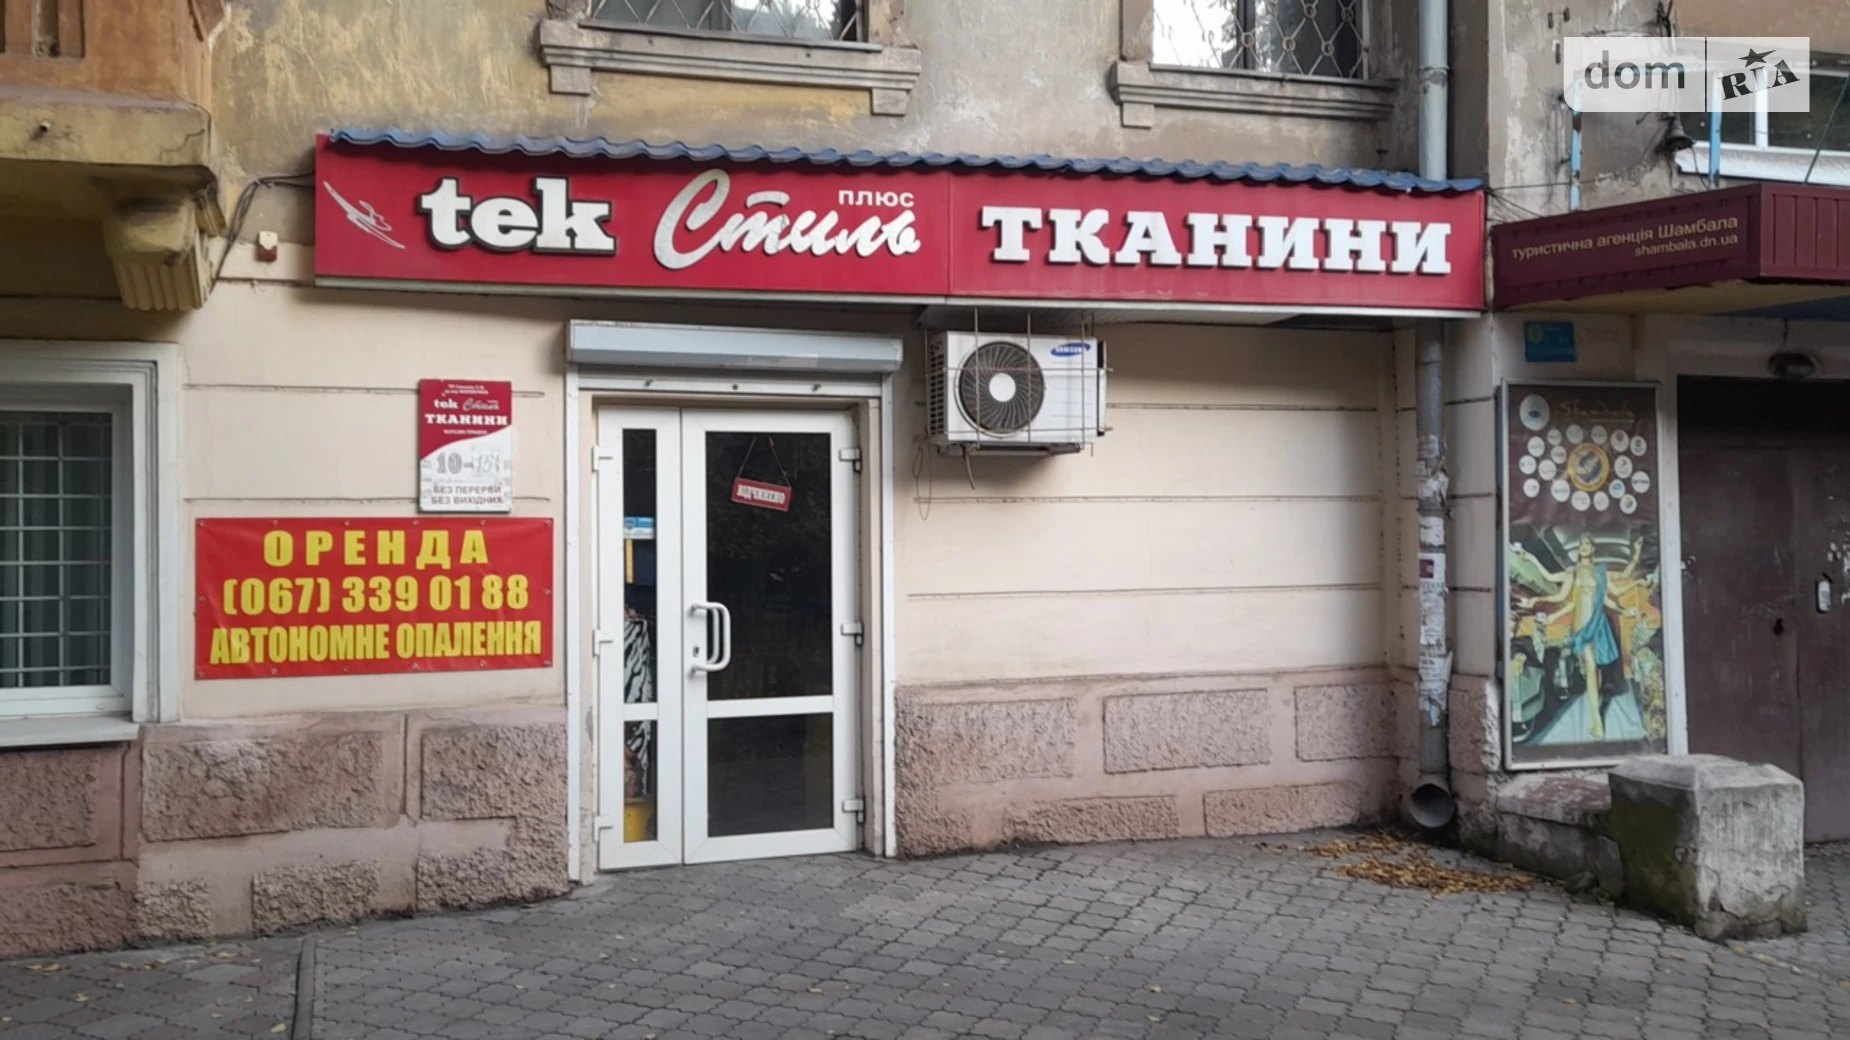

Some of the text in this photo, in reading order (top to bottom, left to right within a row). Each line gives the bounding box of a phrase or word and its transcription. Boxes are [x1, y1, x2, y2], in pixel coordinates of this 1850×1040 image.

[419, 168, 922, 270] tek Стиль
[1511, 216, 1739, 261] туристична агенція Шамбала
[981, 205, 1452, 275] ТКАНИНИ
[1634, 232, 1739, 257] shambala.dn.ua
[424, 413, 508, 426] ТКАНИНИ
[431, 496, 451, 505] БЕЗ
[433, 485, 453, 495] БЕЗ
[263, 530, 489, 570] ОРЕНДА
[223, 577, 331, 615] (067)
[342, 575, 418, 613] 339
[209, 621, 542, 665] АВТОНОМНЕ ОПАЛЕННЯ
